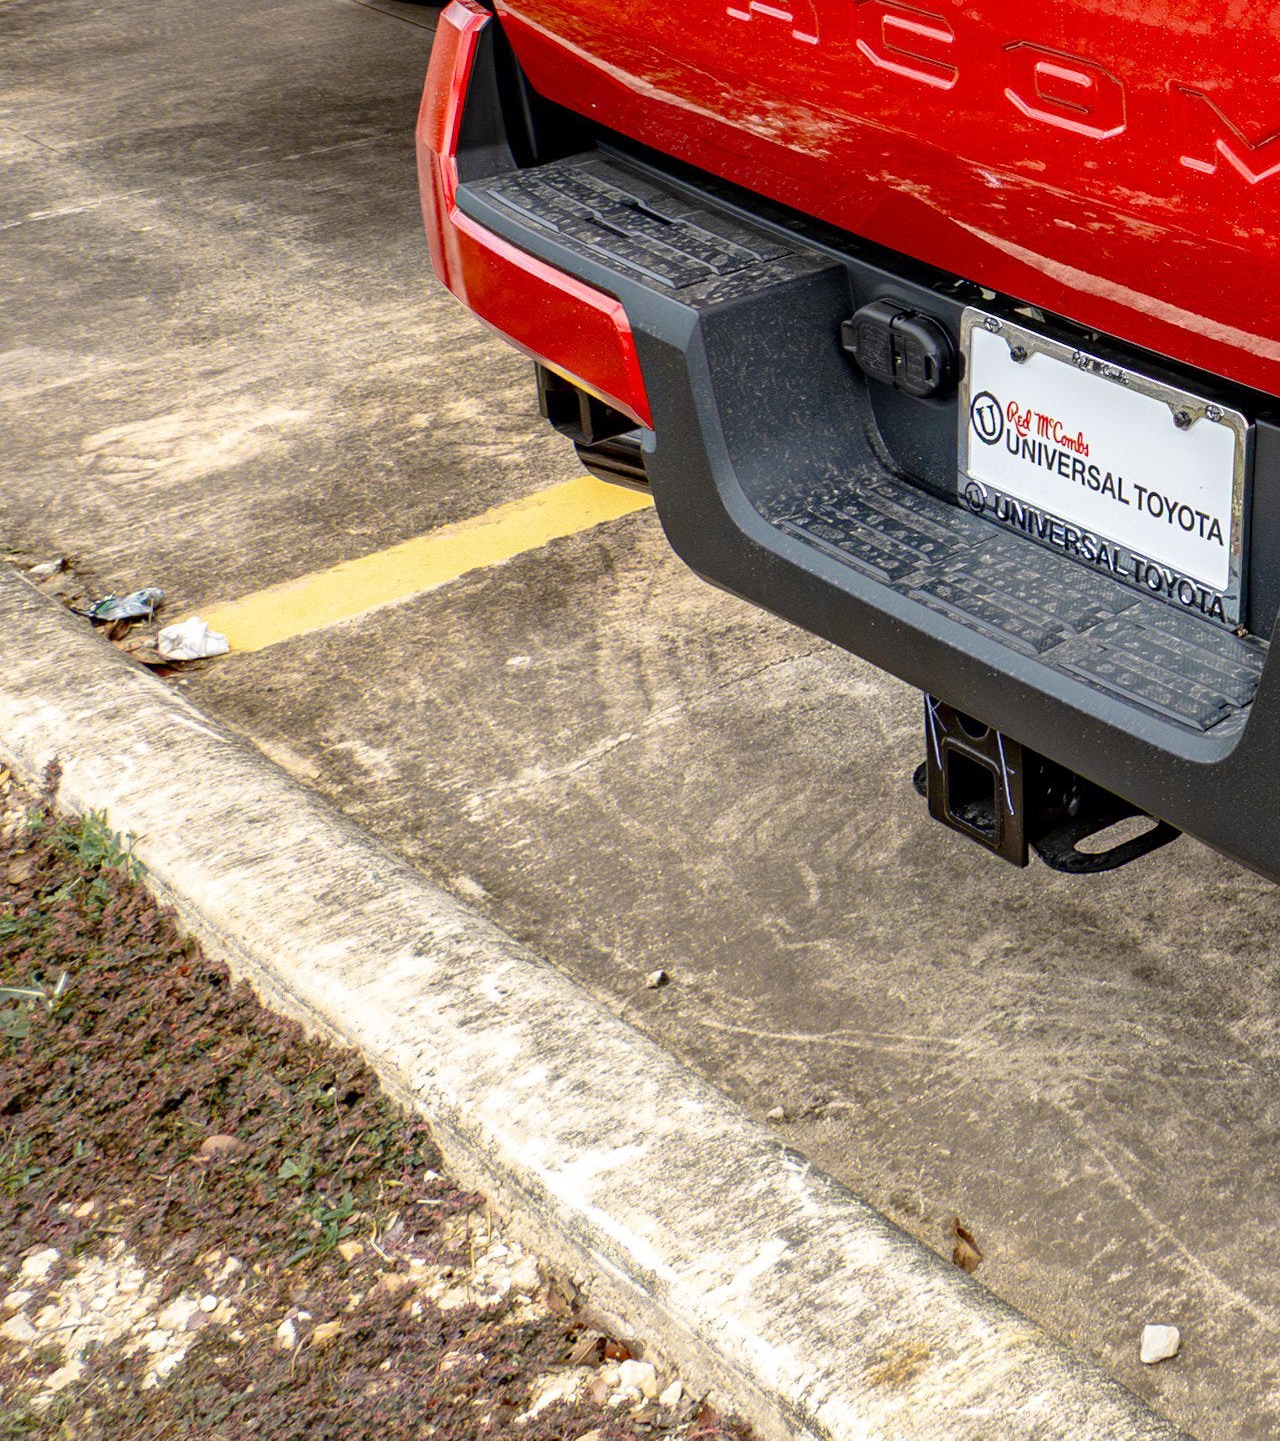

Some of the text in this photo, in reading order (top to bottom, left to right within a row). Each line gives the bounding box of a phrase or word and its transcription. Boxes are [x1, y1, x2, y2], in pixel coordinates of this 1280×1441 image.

[1006, 400, 1090, 457] Red McCombs
[1006, 427, 1224, 547] UNIVERSAL TOYOTA
[993, 491, 1229, 624] UNIVERSAL TOYOTA
